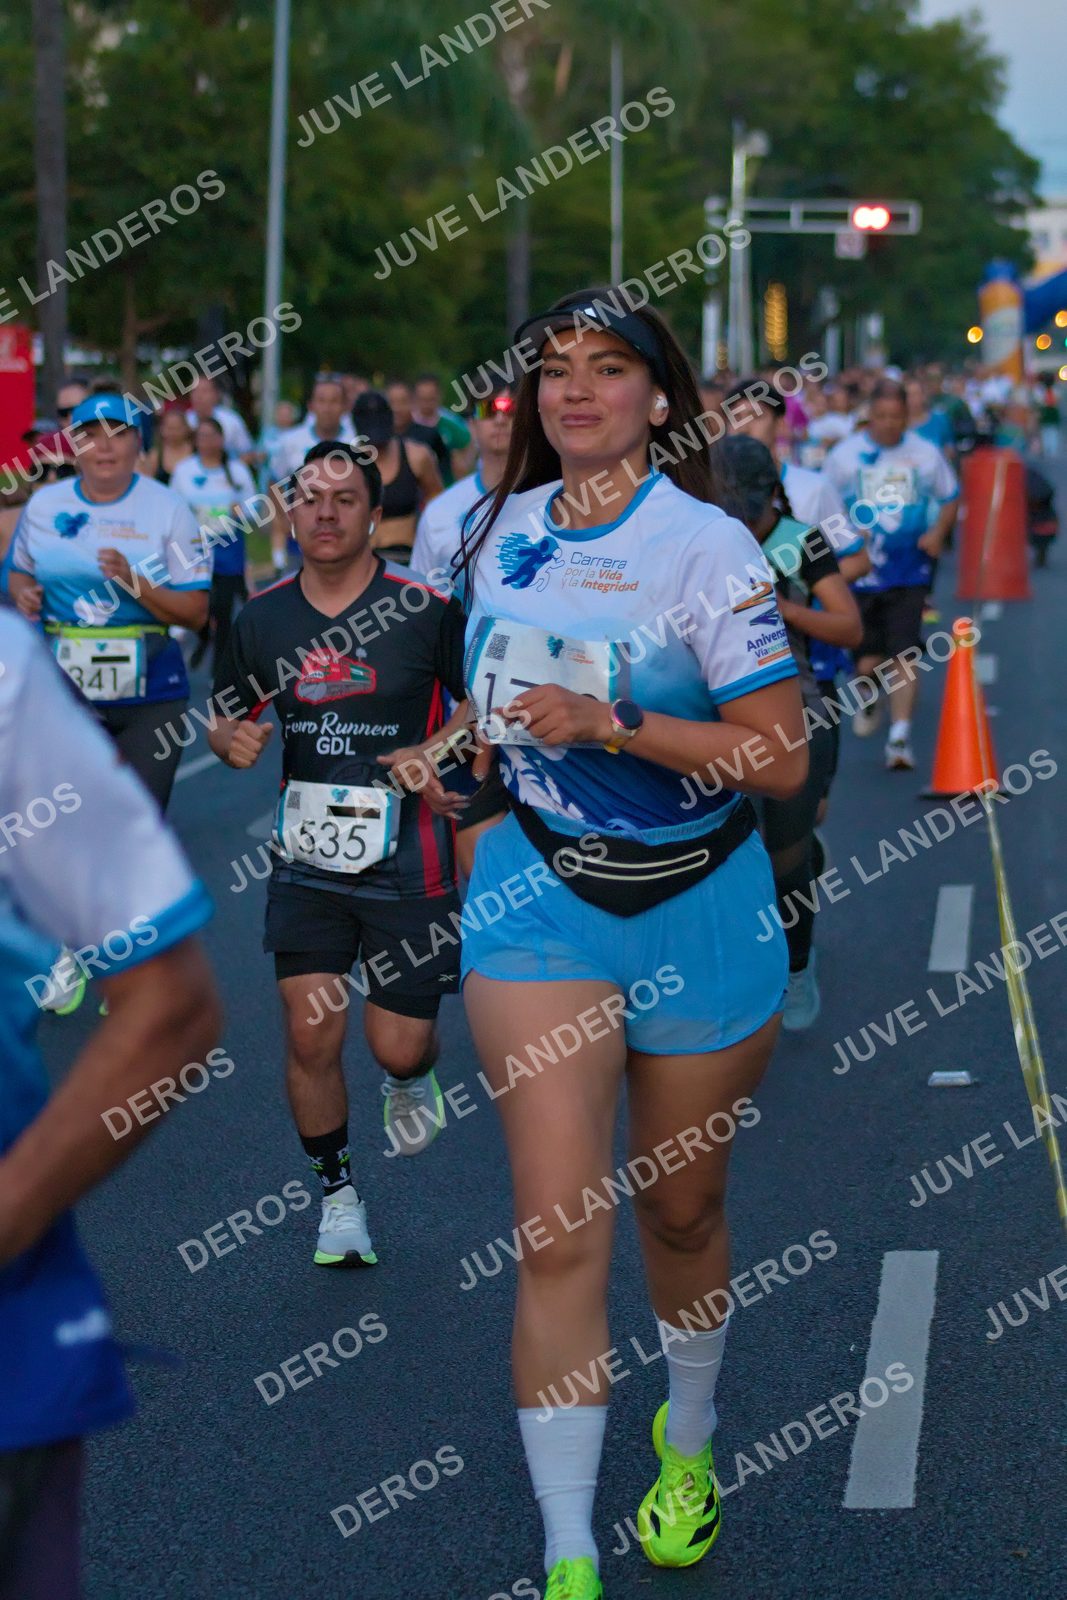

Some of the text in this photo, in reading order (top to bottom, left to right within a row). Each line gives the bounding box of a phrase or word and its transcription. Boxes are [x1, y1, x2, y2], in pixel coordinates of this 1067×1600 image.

[570, 552, 627, 569] Carrera
[565, 567, 623, 580] por la Vida
[568, 577, 578, 587] la
[580, 579, 639, 593] Integridad
[320, 711, 399, 737] Runners
[316, 736, 356, 755] GDL
[299, 819, 367, 861] 535
